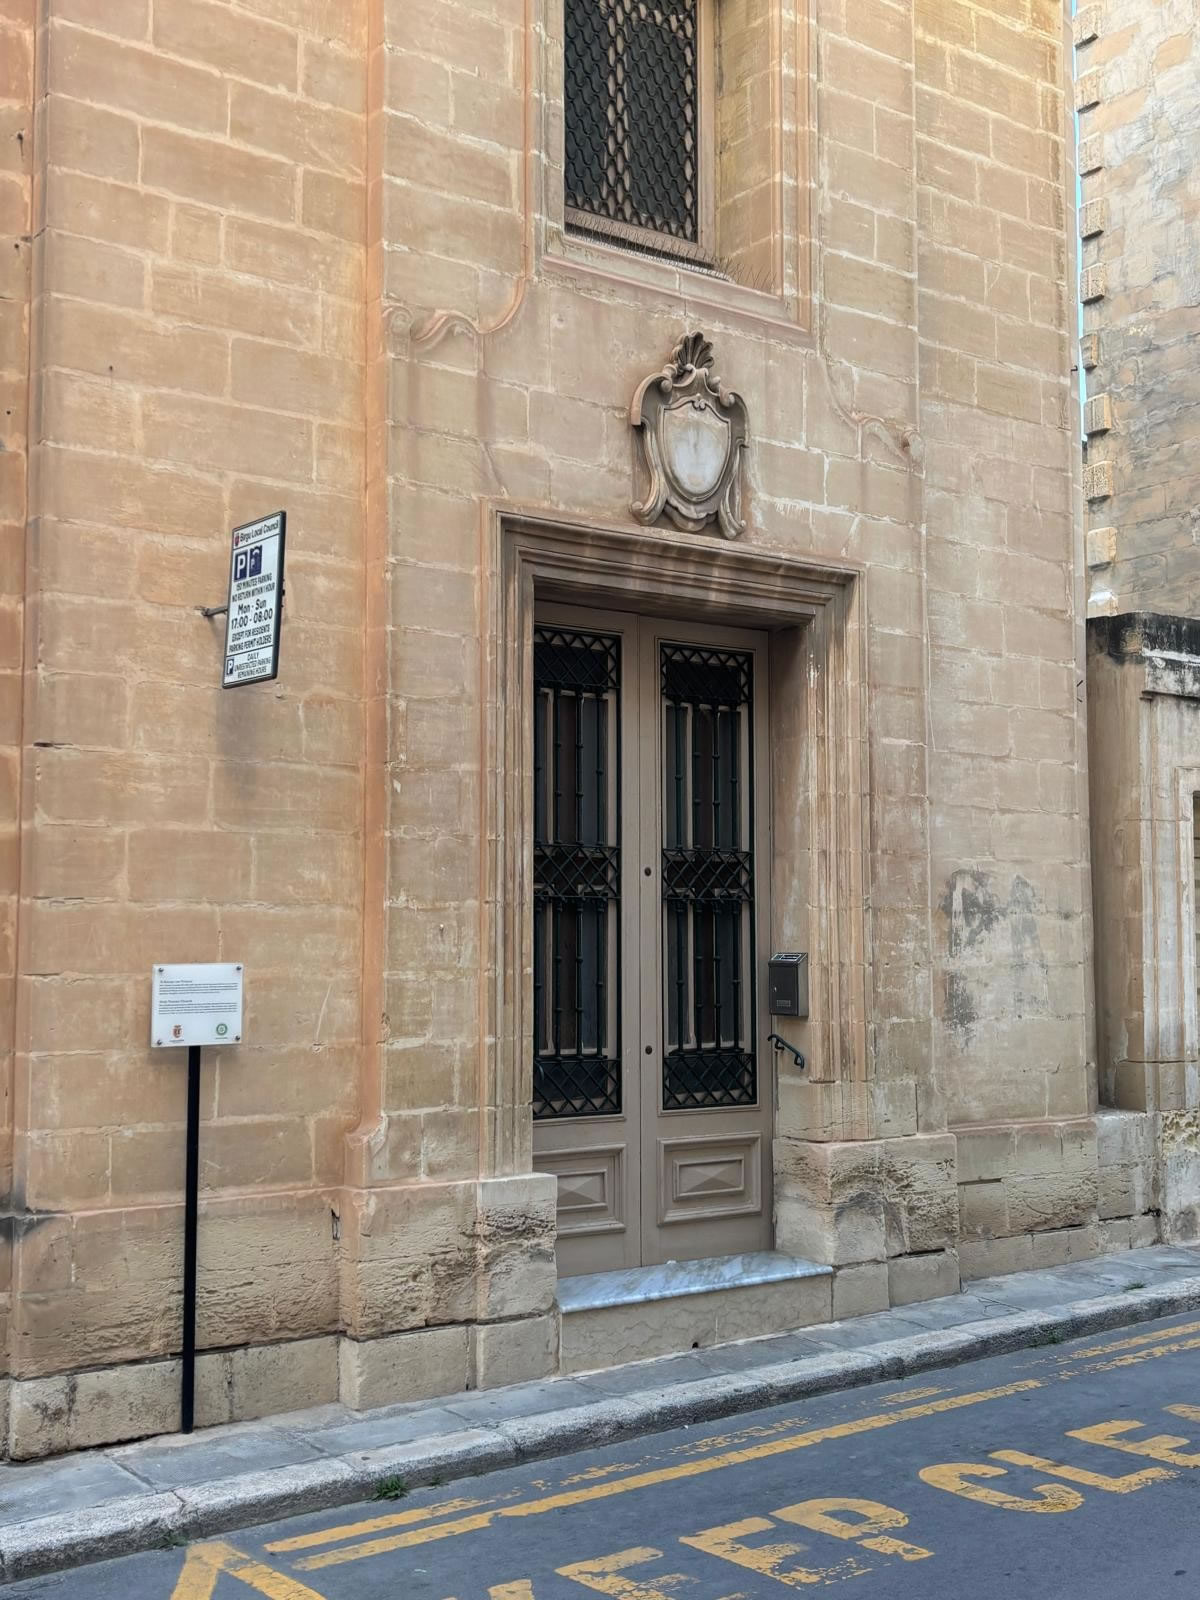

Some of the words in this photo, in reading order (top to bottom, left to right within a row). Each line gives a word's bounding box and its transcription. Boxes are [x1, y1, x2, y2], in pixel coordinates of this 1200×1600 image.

[240, 532, 251, 542] Birgu
[252, 526, 262, 538] Local
[264, 520, 278, 533] Council
[237, 555, 246, 578] P
[242, 577, 257, 589] MINUTES
[258, 573, 272, 584] PARKING
[232, 594, 237, 602] NO
[238, 590, 251, 600] RETURN
[252, 586, 263, 596] WITHIN
[265, 582, 275, 592] HOUR
[238, 603, 250, 615] Mon
[255, 599, 266, 610] Sun
[229, 642, 243, 653] PARKING
[244, 638, 256, 649] PERMIT
[256, 634, 272, 646] HOLDERS
[232, 631, 244, 642] EXCEPT
[235, 660, 256, 672] UNRESTRICTED
[257, 657, 271, 666] PARKING
[247, 652, 259, 661] DAILY
[238, 668, 255, 679] REMAINING
[256, 665, 267, 674] HOURS
[446, 1497, 936, 1600] EEP
[918, 1403, 1200, 1514] CLE
